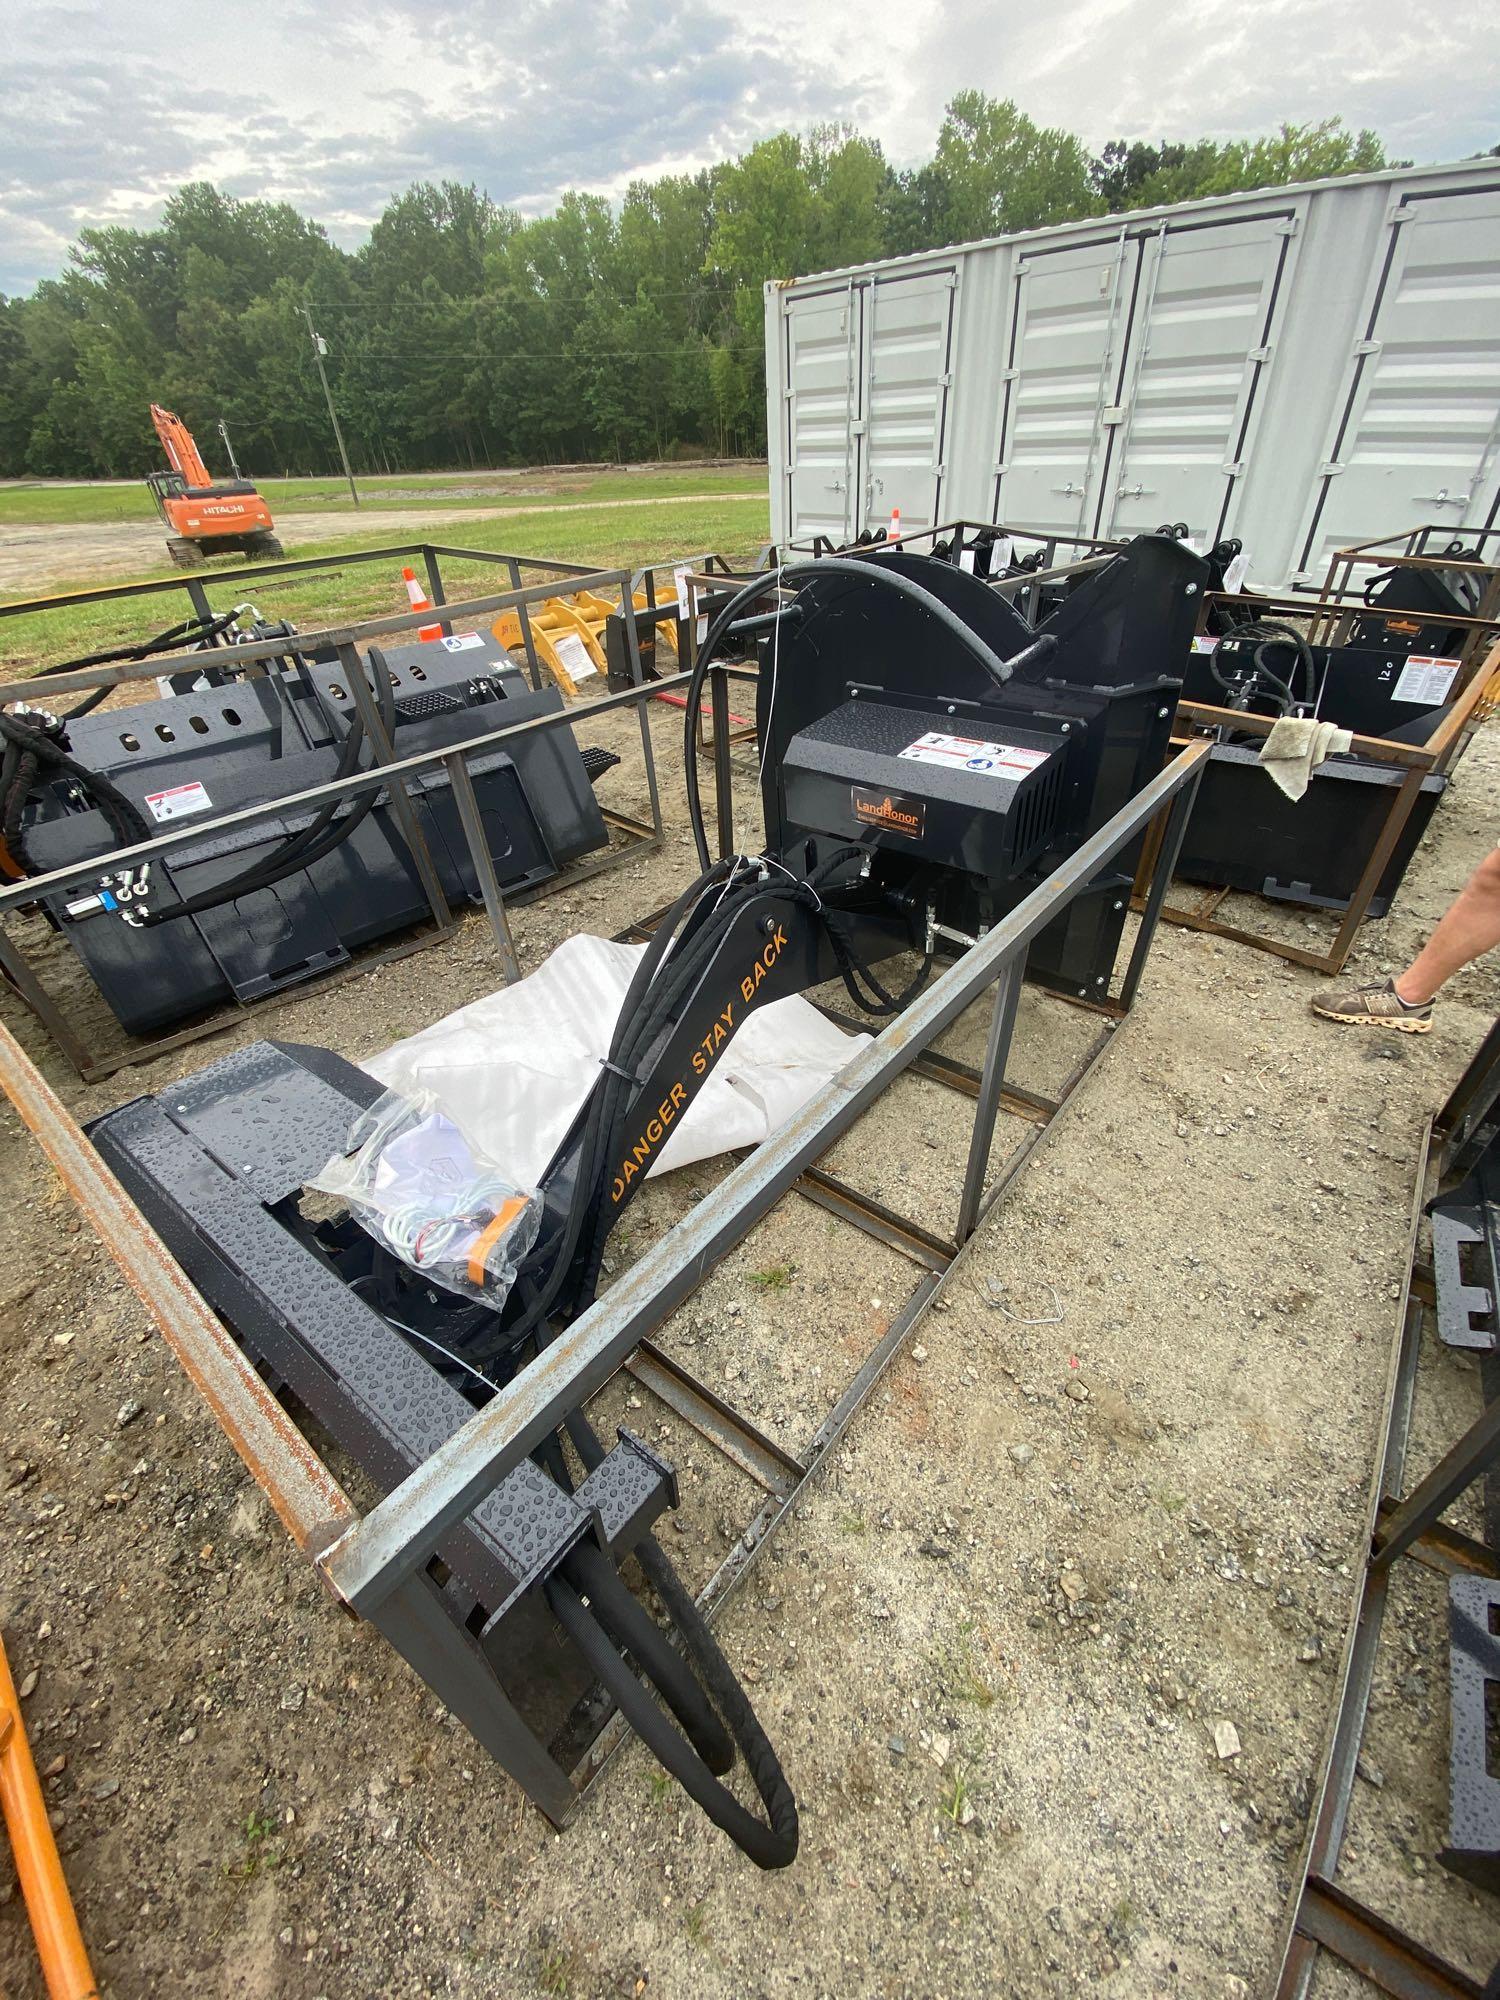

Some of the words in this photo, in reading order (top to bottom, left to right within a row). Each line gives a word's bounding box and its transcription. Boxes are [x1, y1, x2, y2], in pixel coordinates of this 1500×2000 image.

[203, 505, 245, 515] HITACHI
[856, 798, 919, 826] LandHonor
[611, 1081, 688, 1203] DANGER
[691, 1003, 735, 1075] STAY
[740, 924, 789, 1003] BACK
